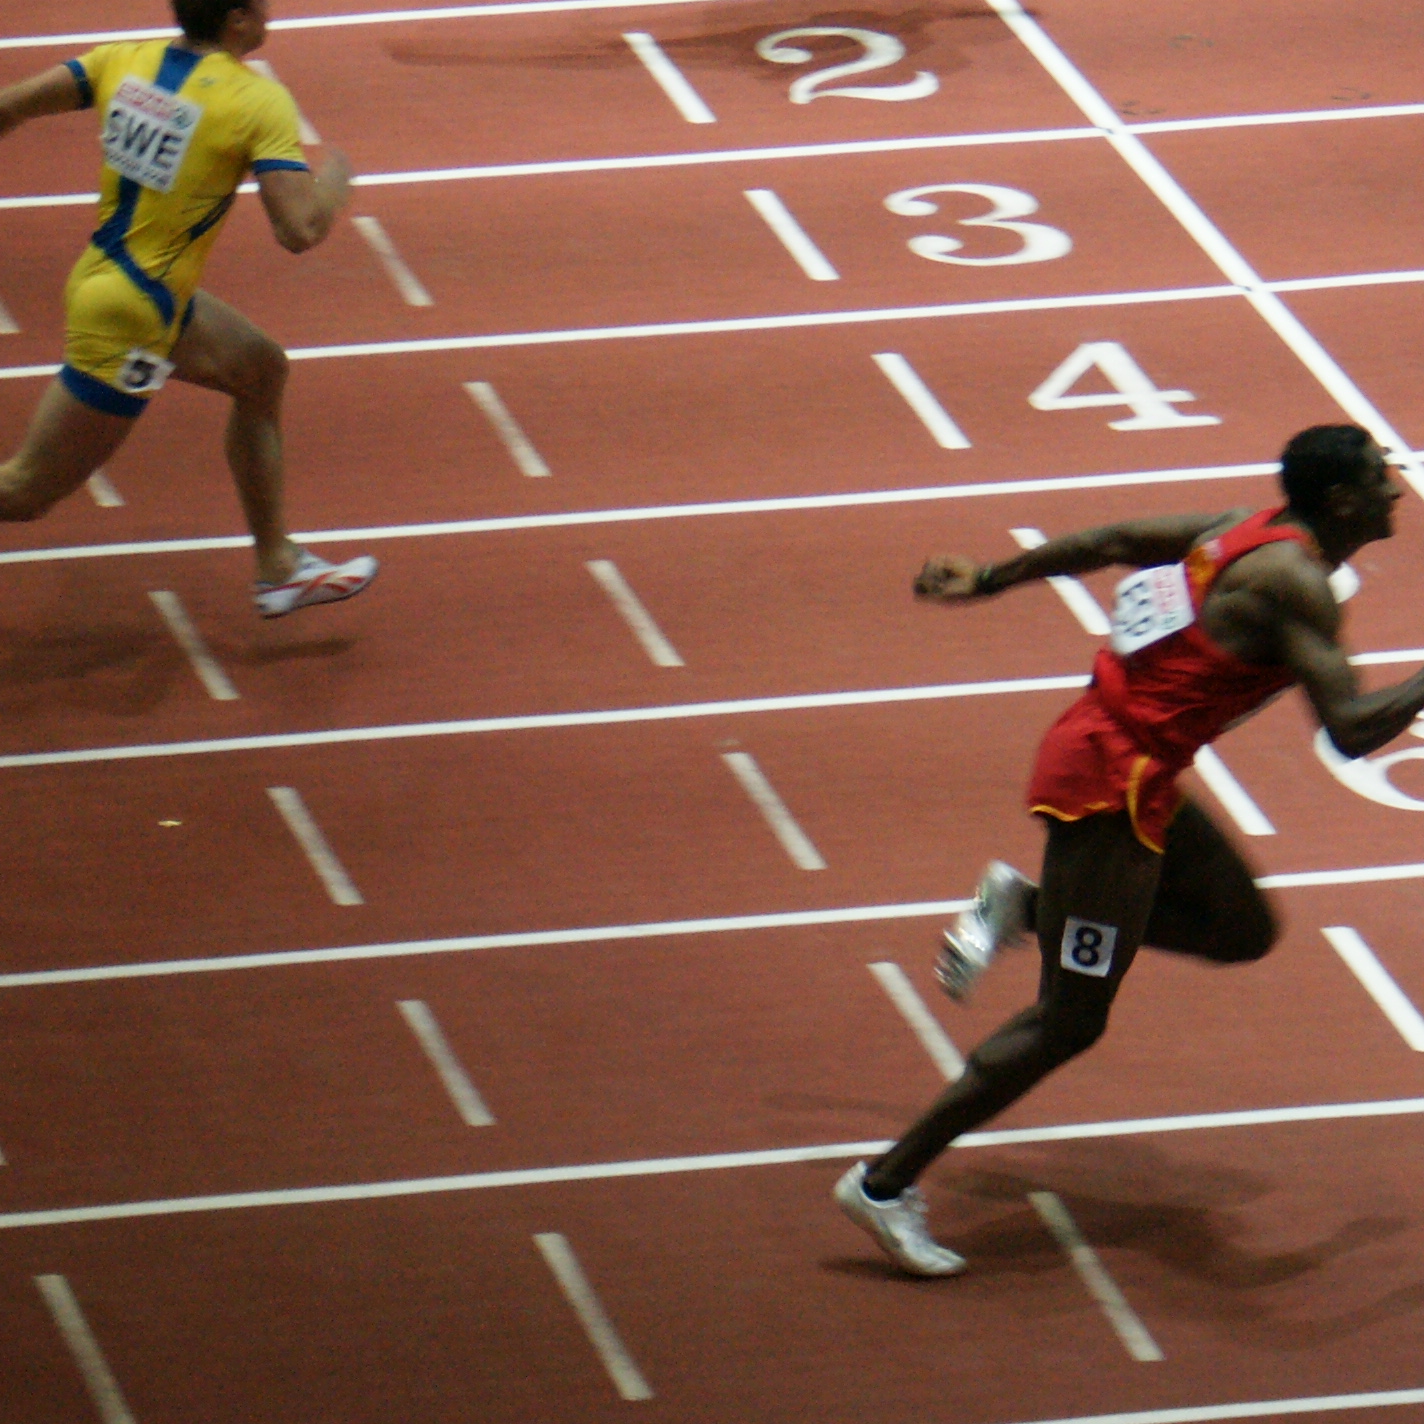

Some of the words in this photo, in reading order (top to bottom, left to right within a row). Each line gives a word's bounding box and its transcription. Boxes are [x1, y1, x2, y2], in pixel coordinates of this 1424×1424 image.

[755, 26, 940, 105] 2
[105, 107, 183, 171] SWE
[883, 182, 1074, 267] 3
[1027, 340, 1224, 432] 4
[1072, 926, 1103, 968] 8
